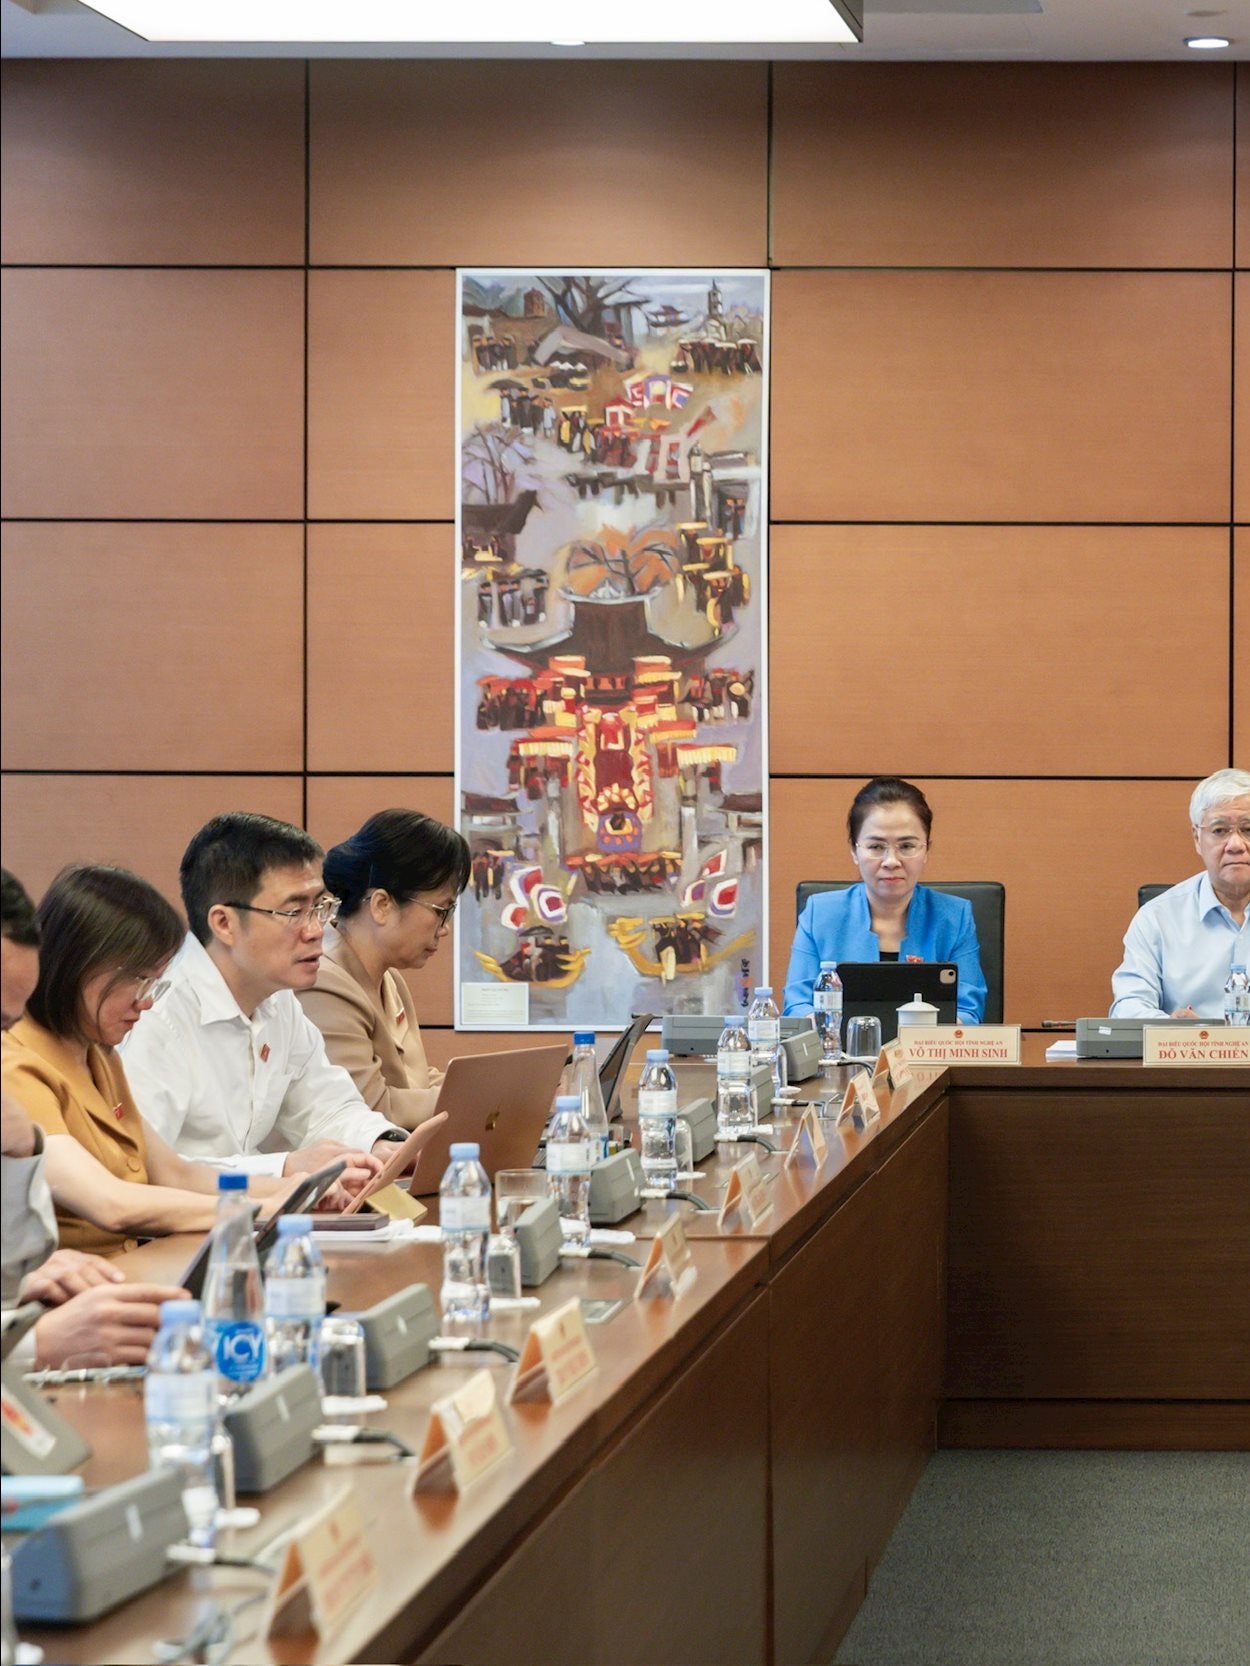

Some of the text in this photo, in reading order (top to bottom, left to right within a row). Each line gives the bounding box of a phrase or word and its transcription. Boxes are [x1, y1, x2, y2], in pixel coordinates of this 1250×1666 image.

[909, 1047, 1008, 1060] VÕ THỊ MINH SINH
[1159, 1048, 1249, 1059] ĐỖ VĂN CHIẾN
[223, 1332, 262, 1363] ICY
